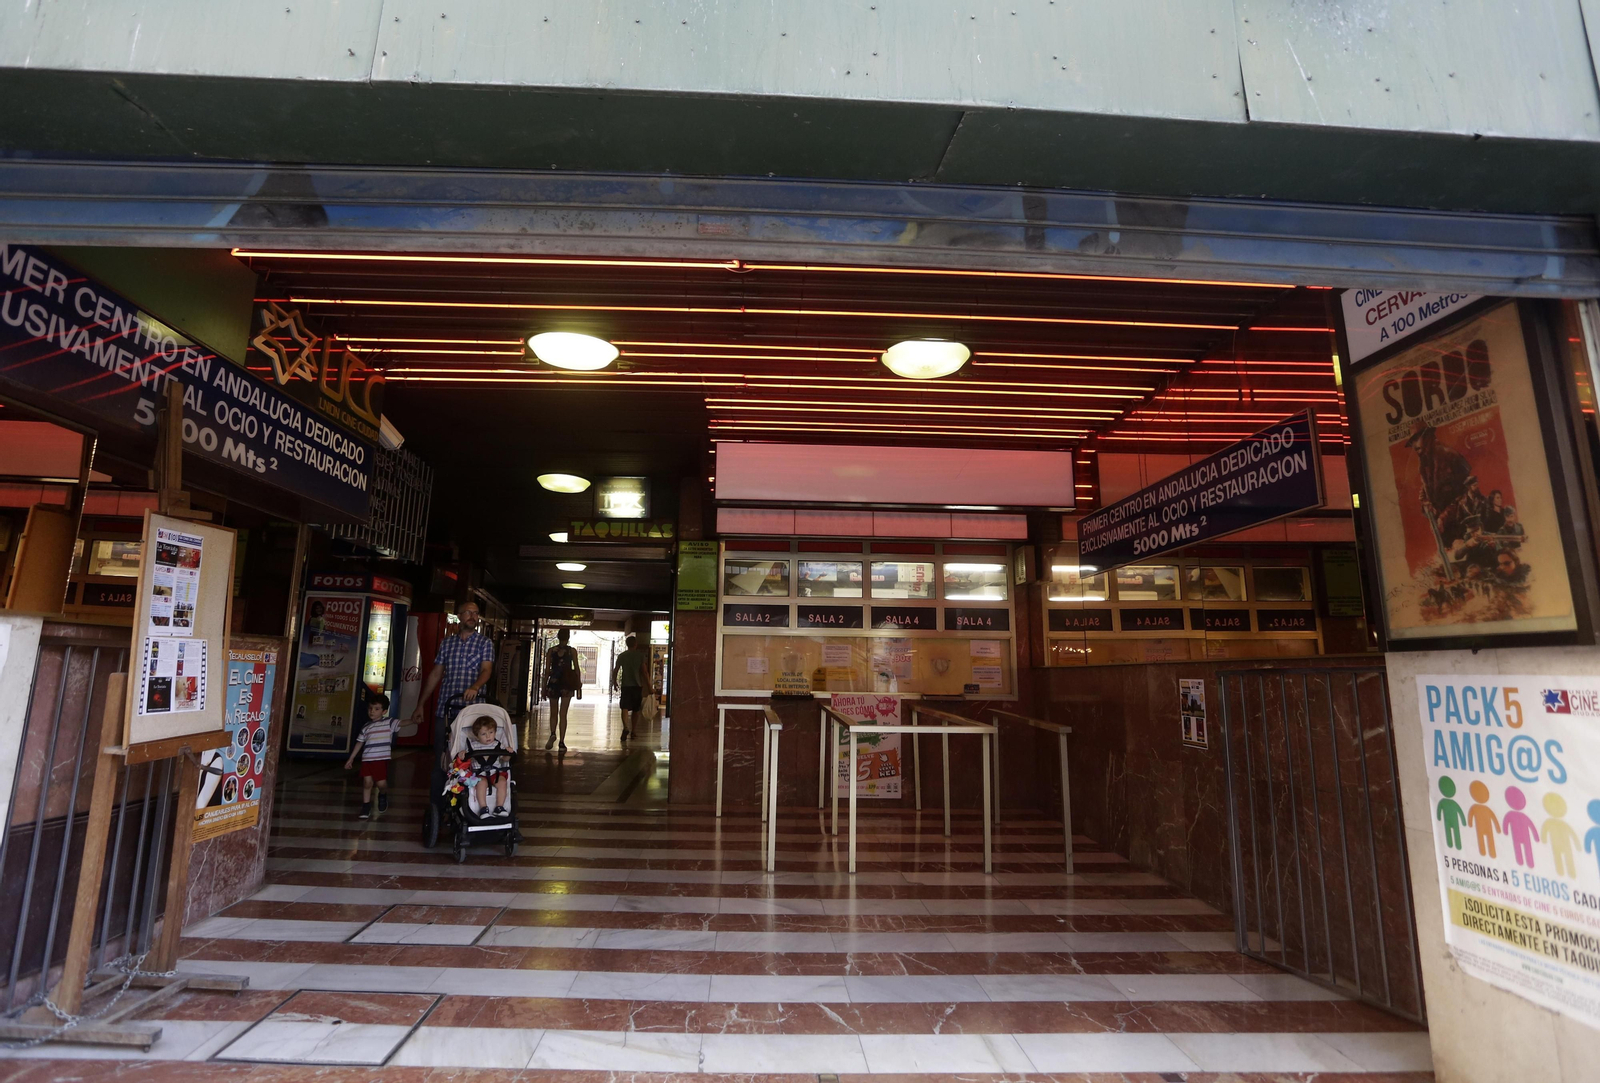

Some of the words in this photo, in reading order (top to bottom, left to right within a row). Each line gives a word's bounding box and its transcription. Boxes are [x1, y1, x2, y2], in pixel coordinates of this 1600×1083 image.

[1365, 290, 1427, 325] CERVA
[1380, 327, 1389, 342] A
[1391, 312, 1415, 334] 100
[74, 286, 178, 362] CENTRO
[181, 346, 212, 382] EN
[212, 367, 302, 432] ANDALUCIA
[305, 417, 365, 465] DEDICADO
[1382, 339, 1492, 425] SORDO
[133, 397, 218, 451] 500
[182, 384, 208, 416] AL
[214, 400, 258, 438] OCIO
[261, 422, 273, 445] Y
[274, 430, 368, 492] RESTAURACION
[1082, 513, 1109, 535] PRIMER
[1109, 497, 1143, 525] CENTRO
[1143, 488, 1156, 510] EN
[1158, 461, 1218, 503] ANDALUCIA
[1220, 426, 1295, 476] DEDICADO
[1080, 517, 1147, 555] EXCLUSIVAMENTE
[1148, 512, 1160, 530] AL
[1162, 498, 1190, 524] OCIO
[1189, 494, 1198, 512] Y
[1199, 450, 1308, 510] RESTAURACION
[570, 521, 674, 539] TAQUILLAS
[1133, 529, 1169, 555] 5000
[313, 575, 364, 587] FOTOS
[374, 575, 404, 595] FOTOS
[325, 600, 361, 614] FOTOS
[735, 612, 762, 622] SALA
[765, 614, 770, 622] 2
[324, 620, 358, 632] DOCUMENTOS
[808, 614, 835, 624] SALA
[839, 615, 844, 624] 2
[885, 615, 912, 625] SALA
[913, 616, 919, 625] 4
[957, 617, 984, 626] SALA
[986, 617, 992, 626] 4
[244, 669, 264, 685] CINE
[500, 652, 509, 693] aquaBona
[239, 688, 253, 705] ES
[833, 697, 856, 707] AHORA
[857, 695, 865, 705] TÚ
[1570, 694, 1600, 711] CINE
[233, 708, 266, 725] REGALO
[857, 705, 875, 716] CÓMO
[1434, 729, 1567, 784] AMIG@S
[1444, 855, 1450, 868] 5
[1452, 857, 1499, 882] PERSONAS
[1502, 872, 1509, 885] A
[1511, 870, 1520, 888] 5
[1524, 873, 1570, 901] EUROS
[1450, 876, 1454, 884] 5
[1455, 877, 1481, 892] AMIG@S
[1488, 886, 1522, 905] ENTRADAS
[1523, 897, 1532, 907] DE
[1534, 900, 1551, 914] CINE
[1464, 897, 1512, 924] ¡SOLICITA
[1514, 912, 1542, 935] ESTA
[1462, 912, 1541, 952] DIRECTAMENTE
[1543, 940, 1559, 959] EN
